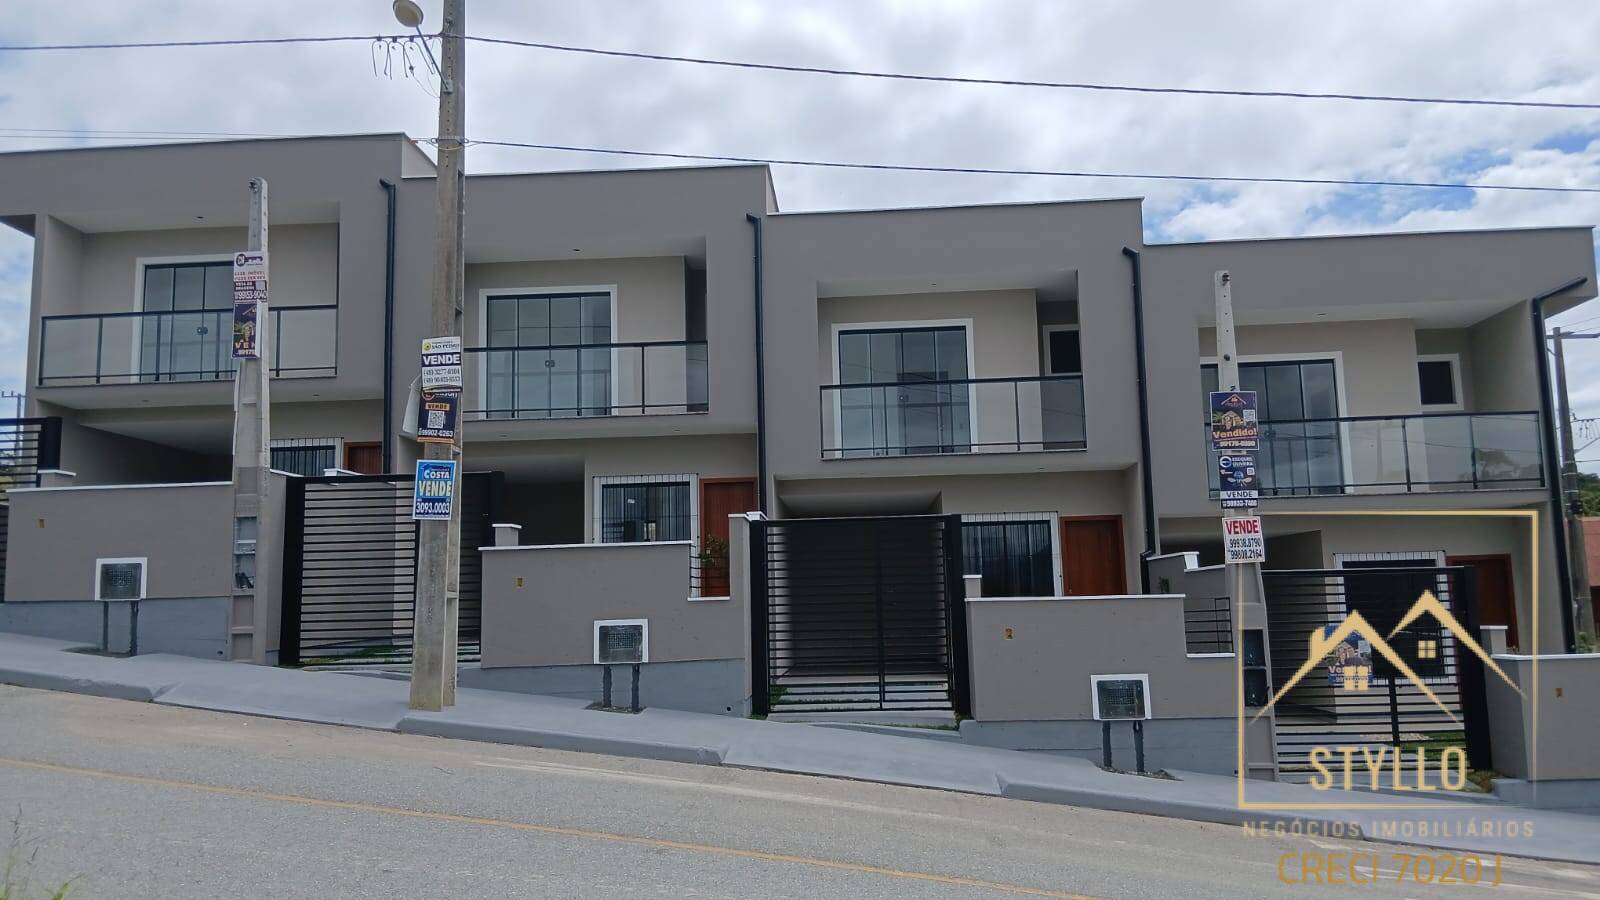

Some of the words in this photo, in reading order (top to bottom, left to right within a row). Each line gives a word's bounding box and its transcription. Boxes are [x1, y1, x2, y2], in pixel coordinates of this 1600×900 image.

[423, 354, 461, 365] VENDE
[1212, 428, 1257, 439] Vendido!
[419, 480, 452, 497] VENDE
[416, 502, 450, 514] 3093.0003
[1225, 520, 1259, 535] VENDE
